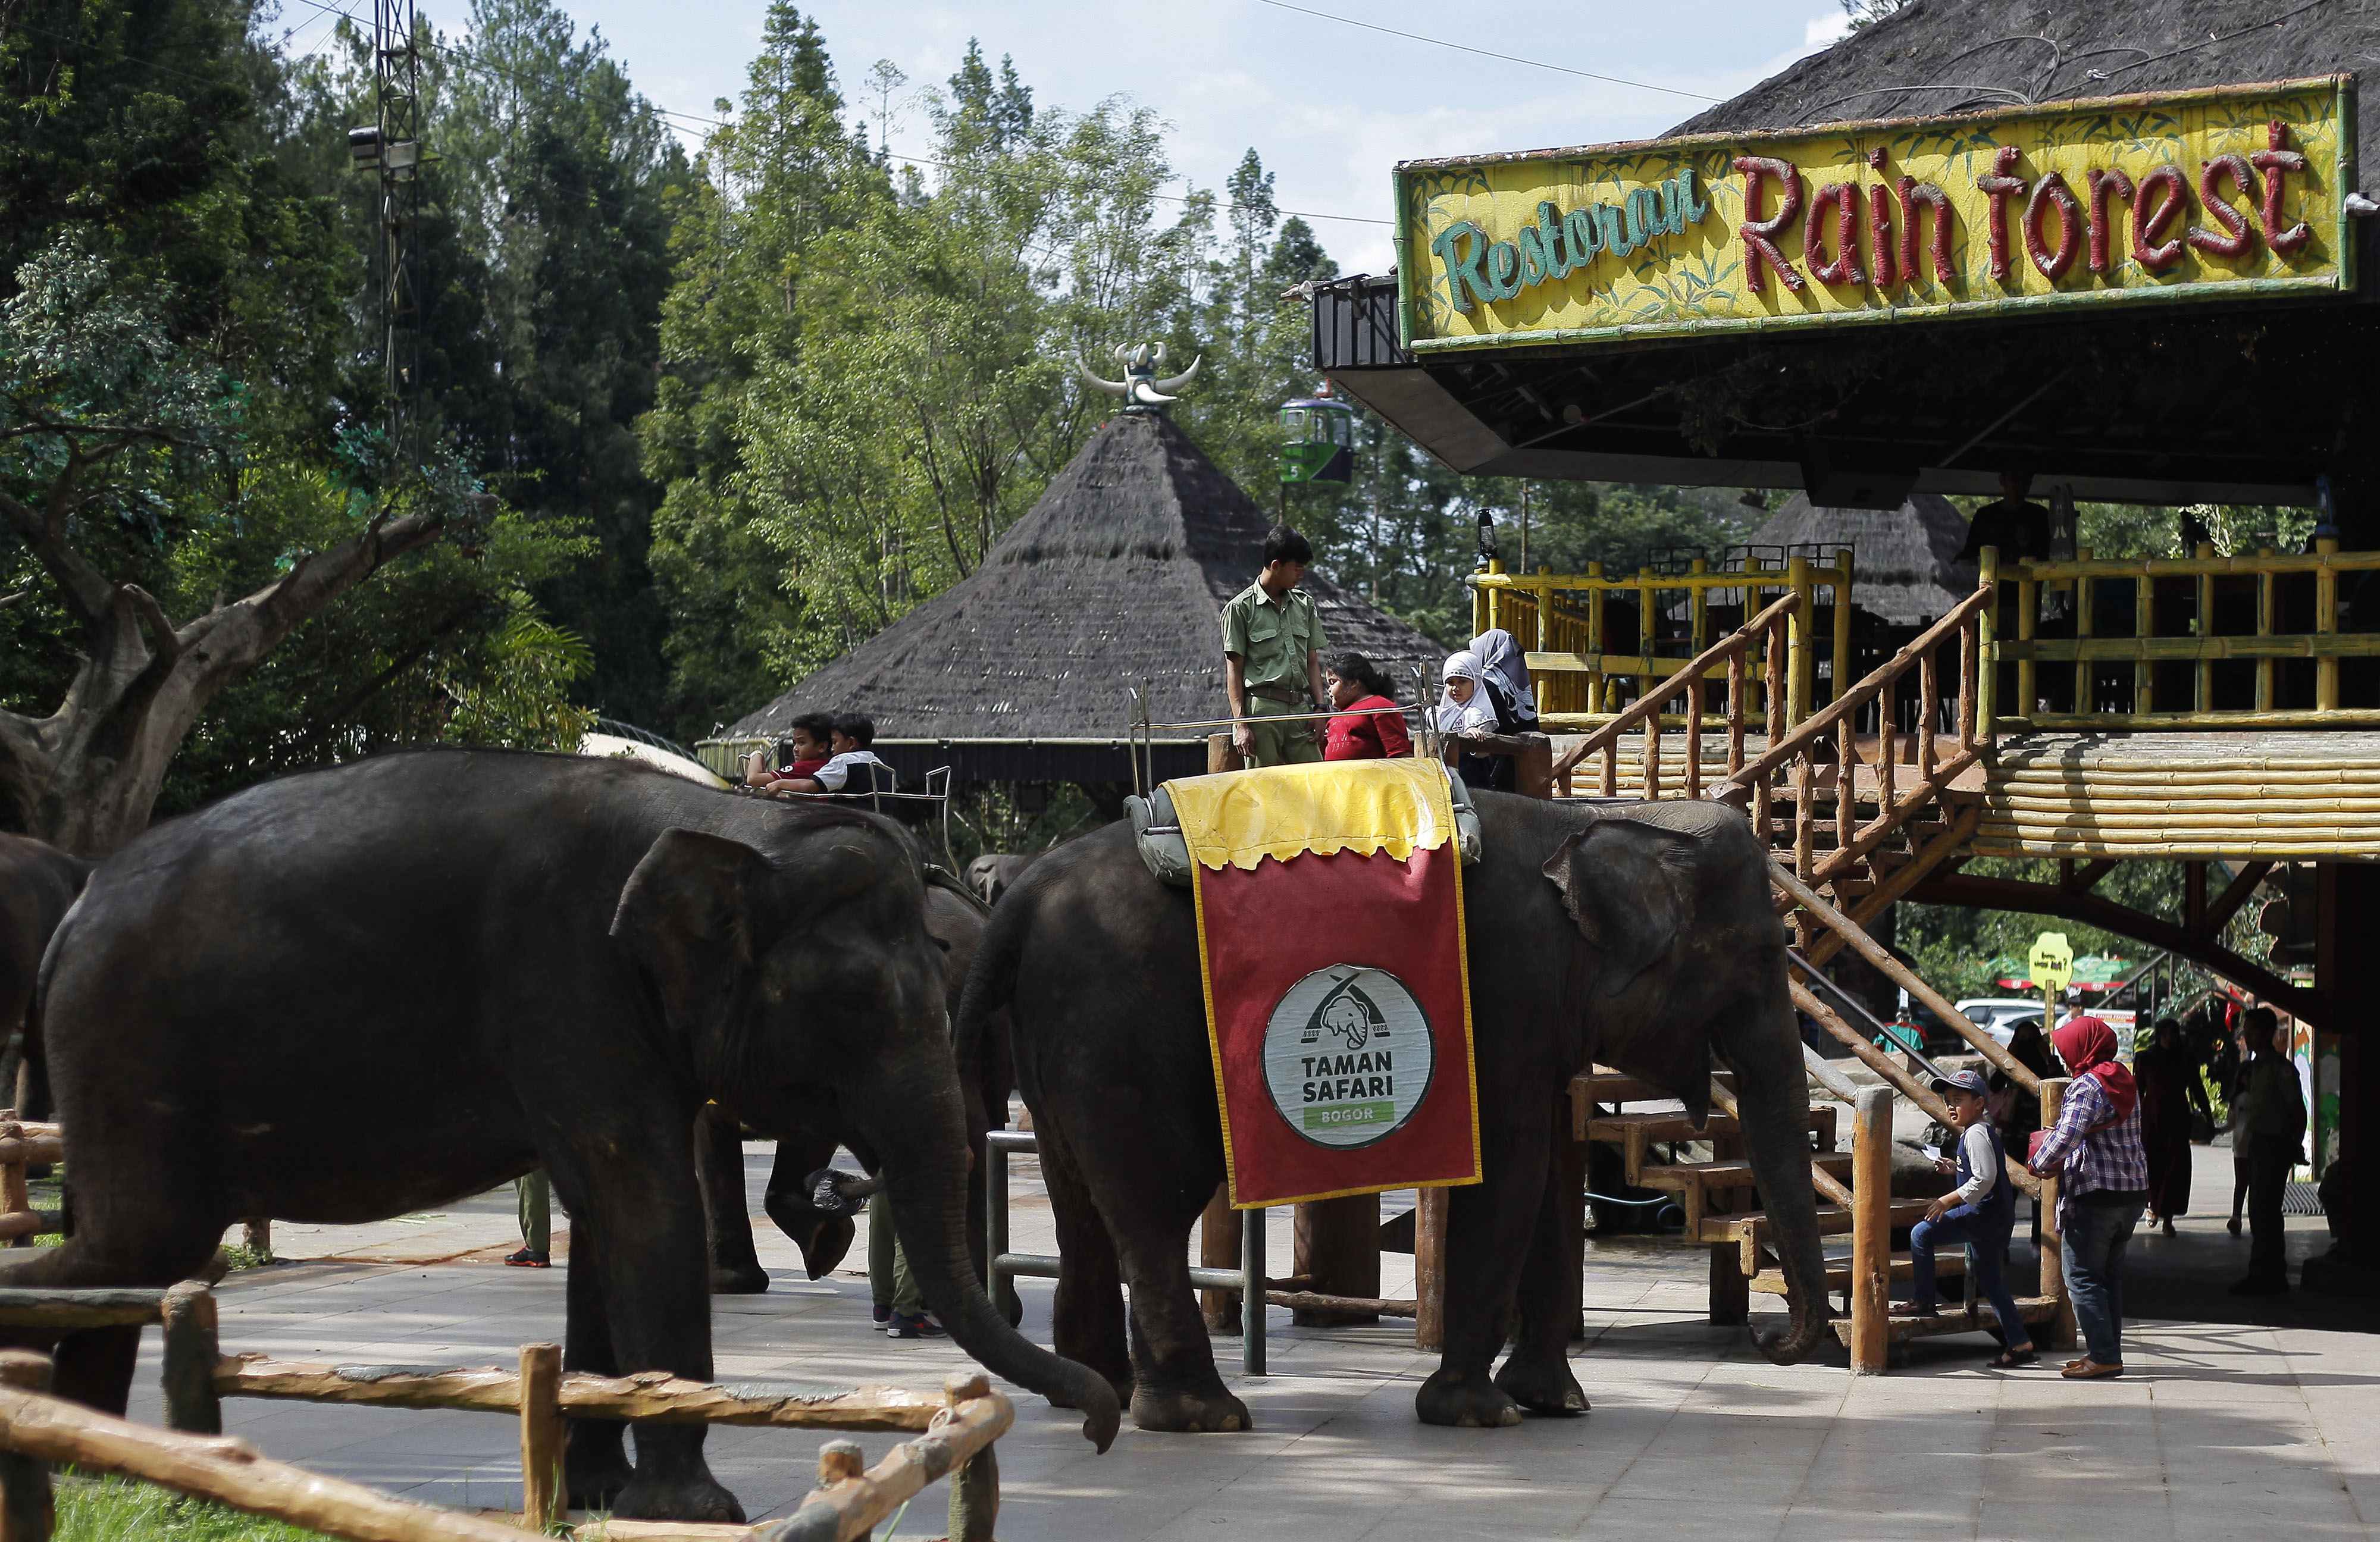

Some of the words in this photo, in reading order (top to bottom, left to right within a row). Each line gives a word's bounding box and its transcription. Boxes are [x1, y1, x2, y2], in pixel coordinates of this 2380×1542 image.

[1432, 168, 1709, 314] Restoran
[1301, 1051, 1392, 1077] TAMAN
[1302, 1076, 1393, 1102] SAFARI
[1321, 1108, 1373, 1124] BOGOR
